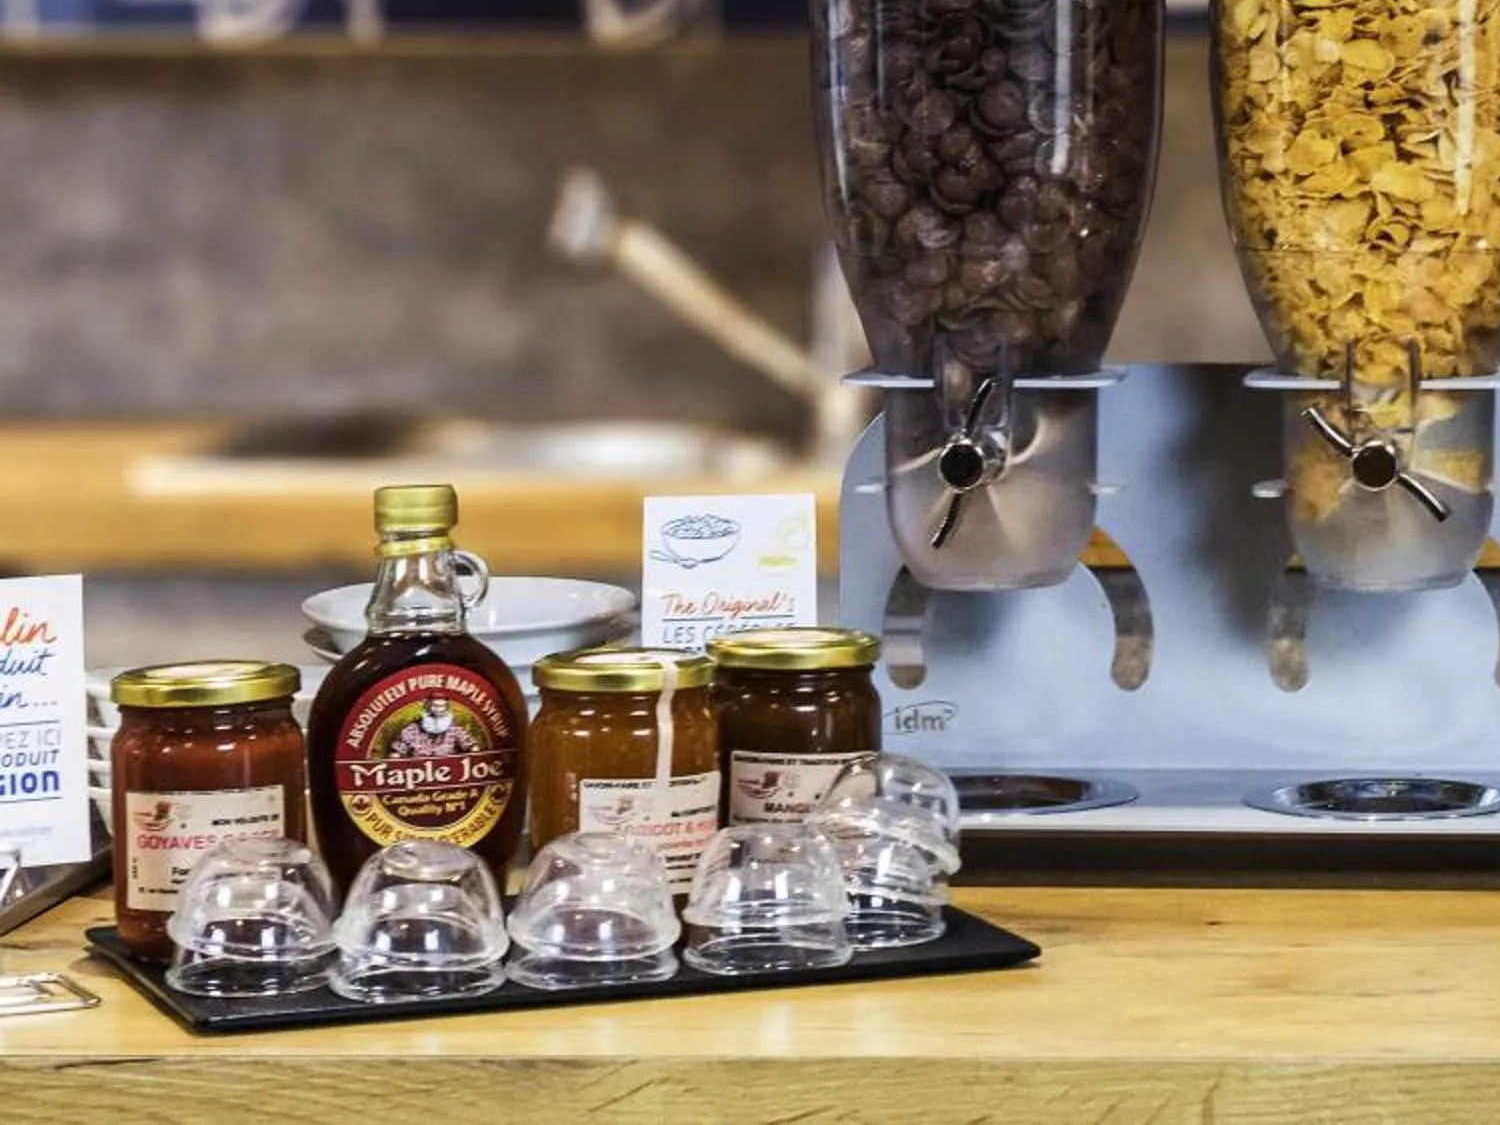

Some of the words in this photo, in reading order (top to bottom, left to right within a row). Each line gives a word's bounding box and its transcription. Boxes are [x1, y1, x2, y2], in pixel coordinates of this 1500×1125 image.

[661, 593, 697, 615] The
[662, 626, 695, 644] LES
[346, 682, 407, 748] ABSOLUTELY
[408, 674, 445, 692] PURE
[445, 675, 487, 705] MAPLE
[0, 730, 30, 749] EZ
[350, 761, 451, 790] Maple
[460, 758, 504, 783] Joe
